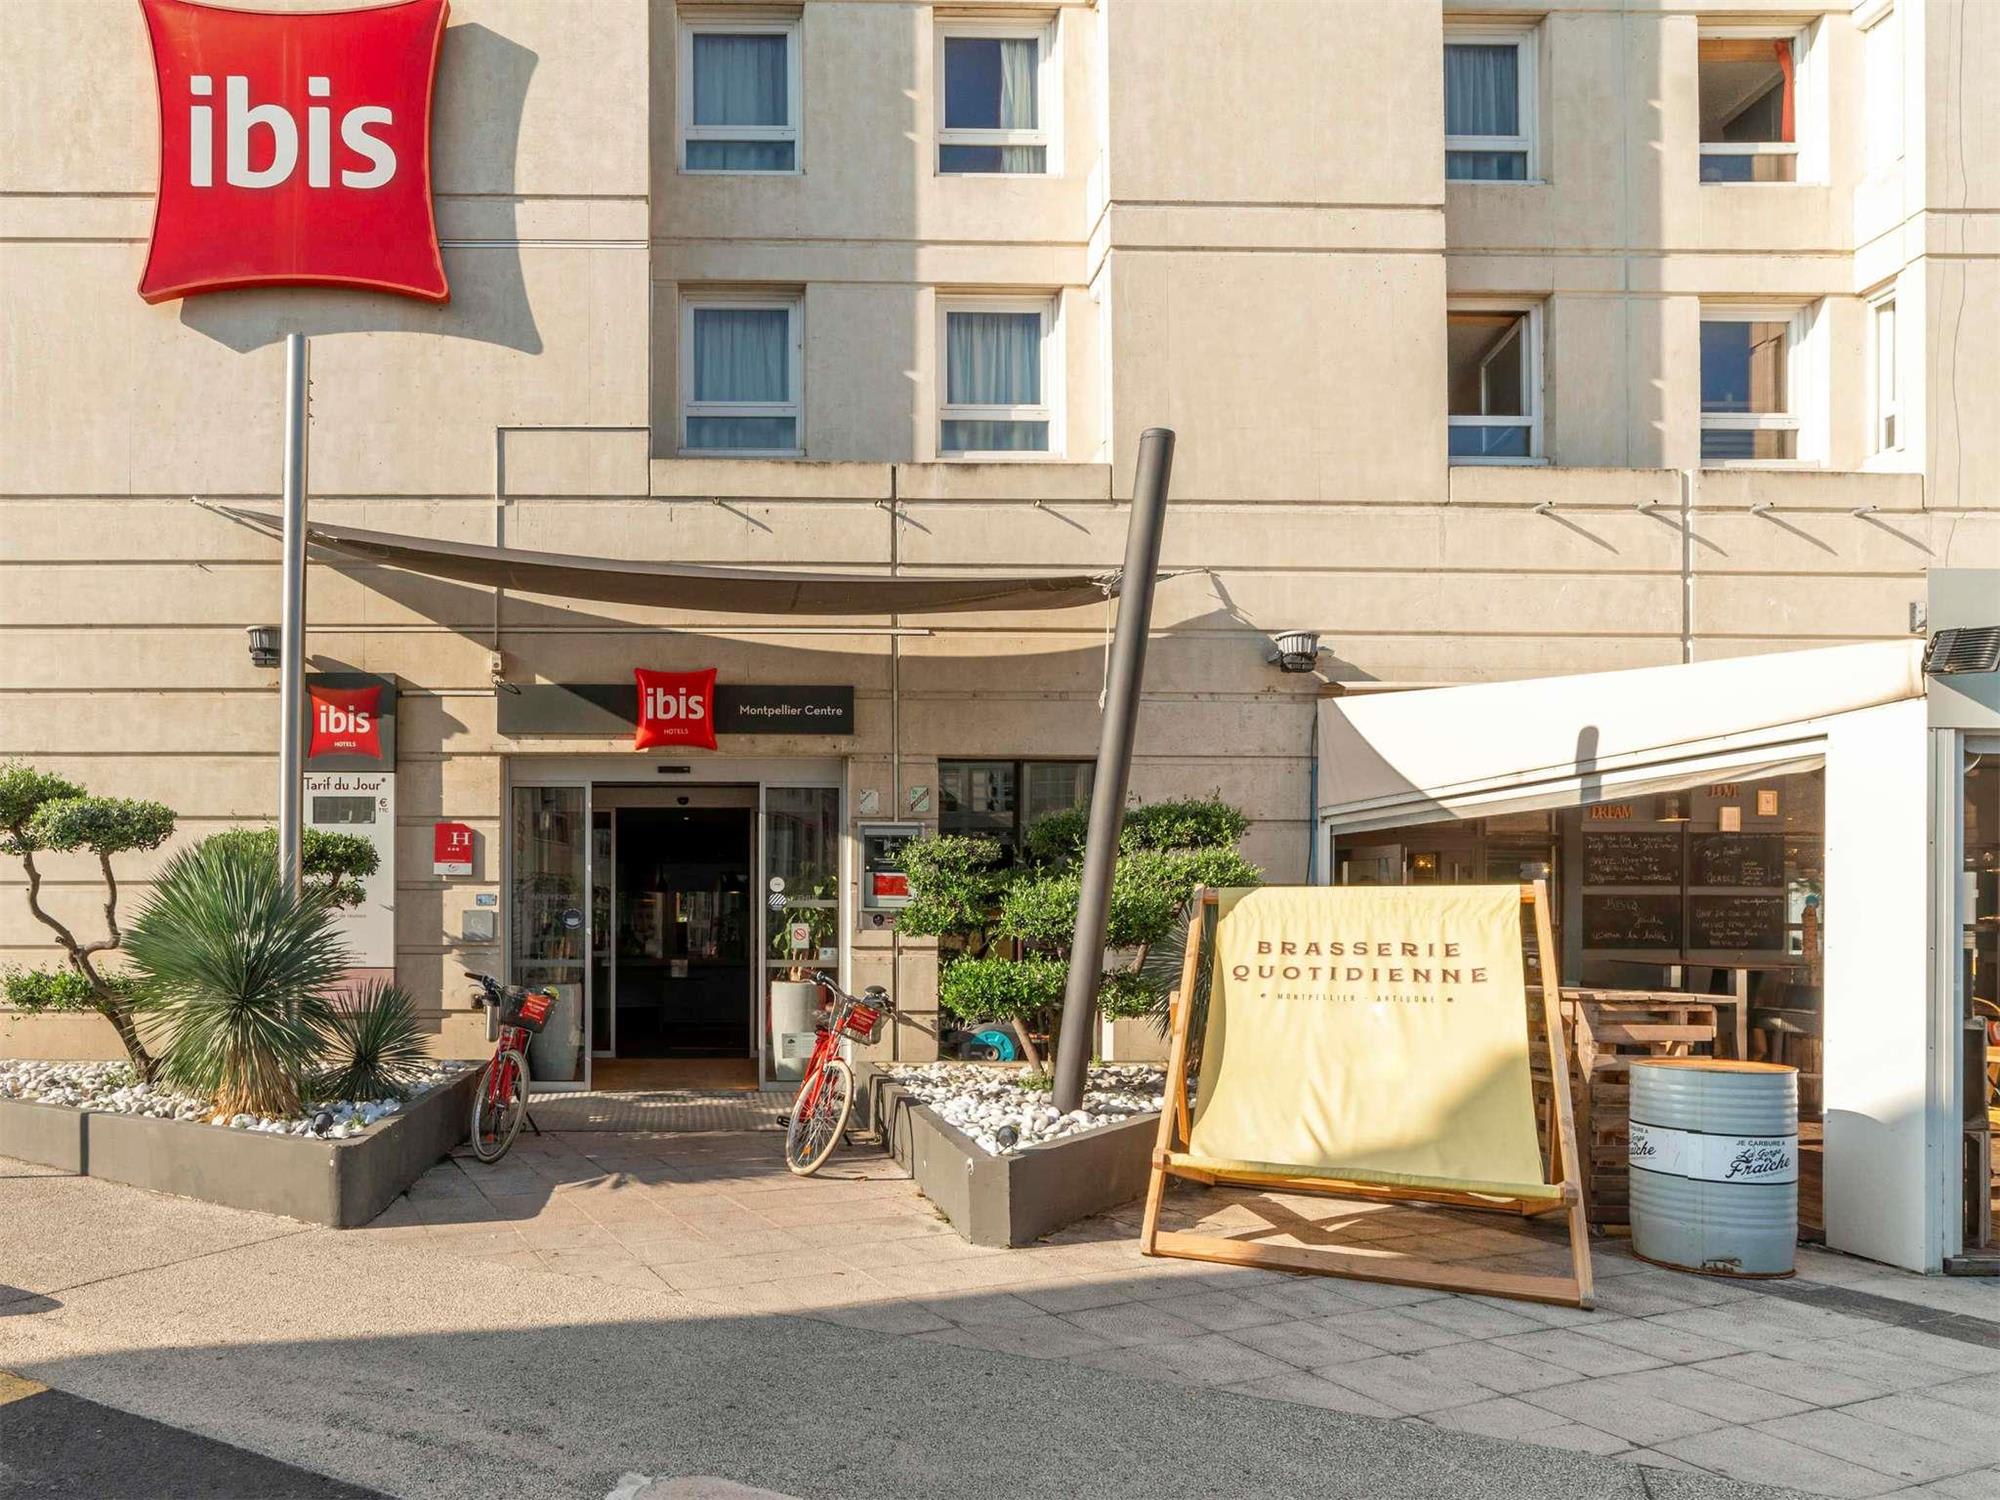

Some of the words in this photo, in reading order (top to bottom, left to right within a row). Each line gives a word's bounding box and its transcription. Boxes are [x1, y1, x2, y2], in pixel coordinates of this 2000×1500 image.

[190, 75, 397, 189] ibis
[646, 688, 705, 720] ibis
[320, 705, 371, 733] ibis
[739, 704, 802, 720] Montpellier
[804, 704, 843, 716] Centre
[303, 776, 331, 791] Tarif
[334, 776, 349, 791] du
[380, 798, 388, 808] €
[1591, 805, 1633, 820] DREAM
[451, 831, 472, 845] H
[1257, 941, 1461, 957] BRASSERIE
[1232, 964, 1488, 984] QUOTIDIENNE
[1277, 993, 1356, 1001] MONTPELLIER
[1736, 1149, 1754, 1162] La
[1757, 1149, 1782, 1161] Gorge
